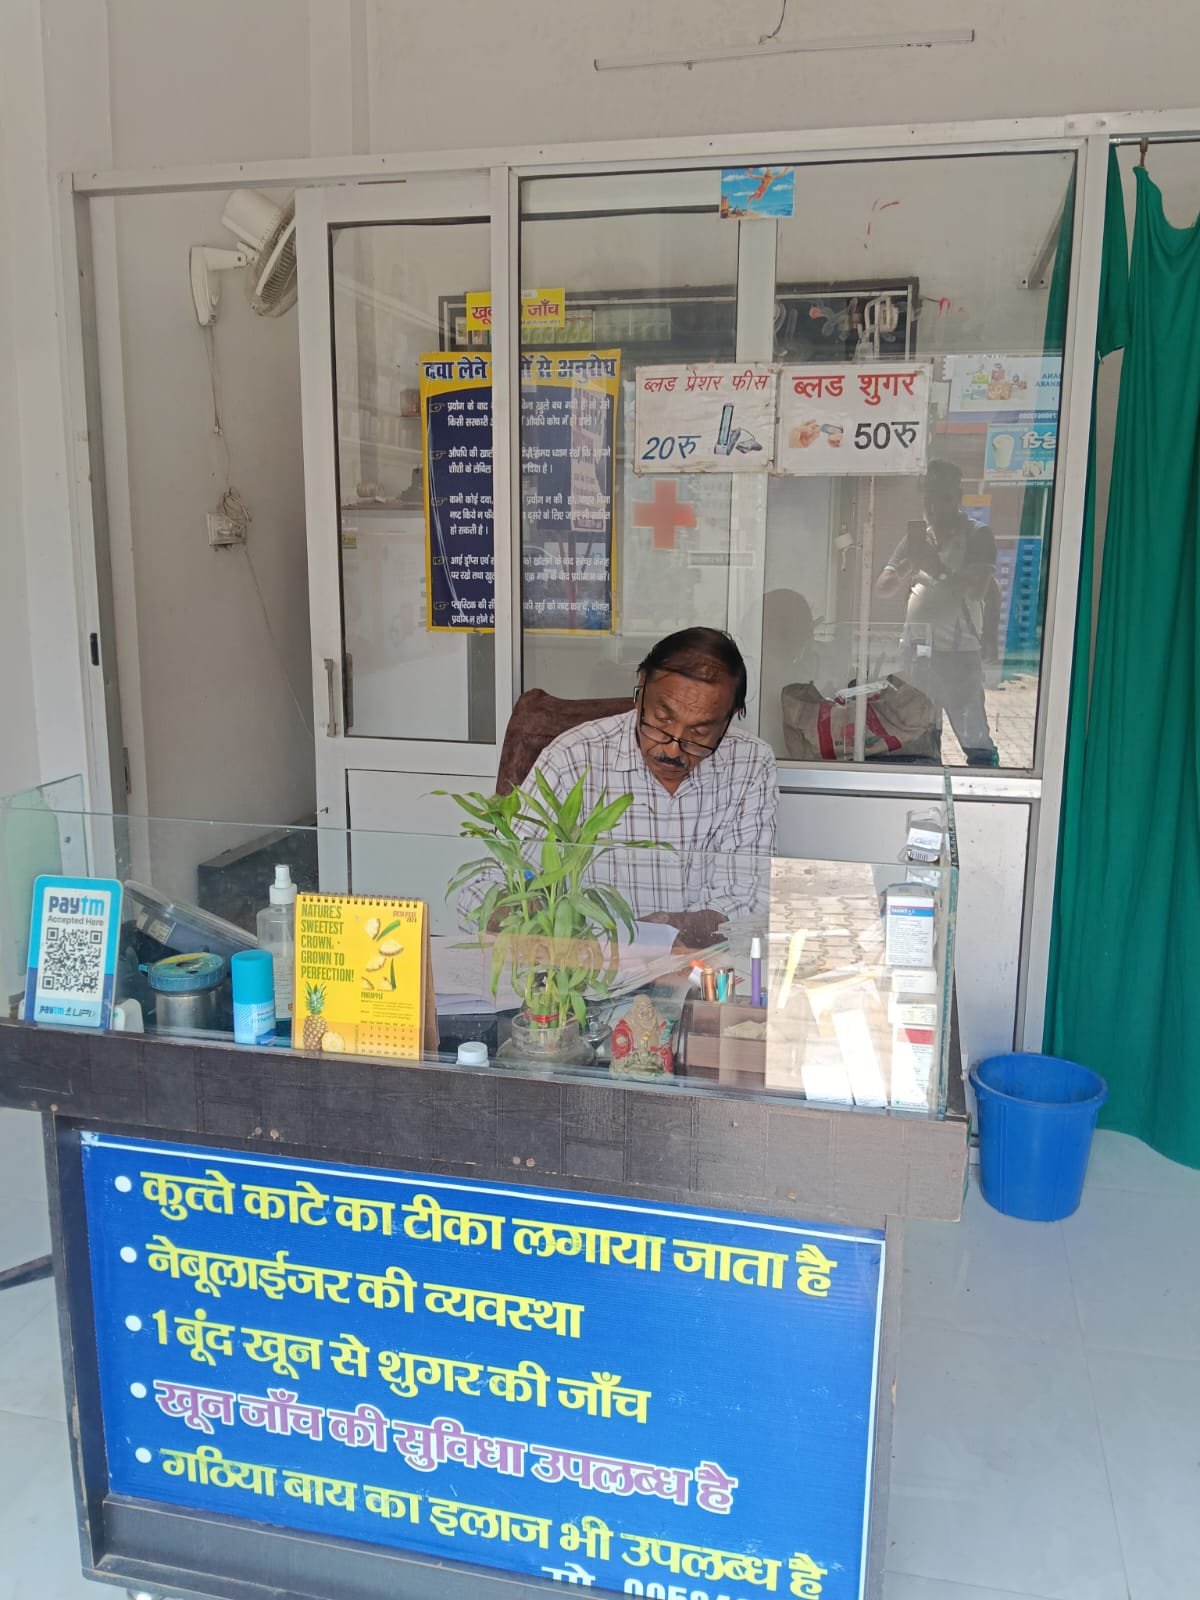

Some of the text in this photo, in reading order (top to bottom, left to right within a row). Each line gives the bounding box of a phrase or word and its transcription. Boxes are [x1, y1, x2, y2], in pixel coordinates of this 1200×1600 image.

[527, 299, 559, 316] जाँच
[423, 361, 455, 380] दवा
[456, 355, 487, 380] लेने
[557, 354, 617, 384] अनुरोध
[643, 369, 770, 393] ब्लड प्रेशर फीस
[791, 373, 918, 406] ब्लड शुगर
[641, 434, 702, 460] 20रु
[853, 420, 920, 450] 50रु
[47, 914, 104, 927] Accepted Here
[301, 919, 344, 935] SWEETEST
[301, 950, 345, 966] GROWN TO
[301, 965, 355, 983] PERFECTION!
[139, 1169, 838, 1298] कुत्ते काटे का टीका लगाया जाता है
[145, 1234, 585, 1339] नेबूलाईजर की व्यवस्था
[152, 1307, 652, 1425] 1 बूंद खून से शुगर की जाँच
[153, 1379, 739, 1516] खून जाँच की सुविधा उपलब्ध है
[159, 1445, 277, 1497] गठिया
[282, 1469, 358, 1513] बाय
[363, 1483, 423, 1525] का
[428, 1496, 553, 1550] इलाज
[558, 1514, 615, 1561] भी
[619, 1531, 783, 1593] उपलब्ध
[788, 1551, 829, 1600] है
